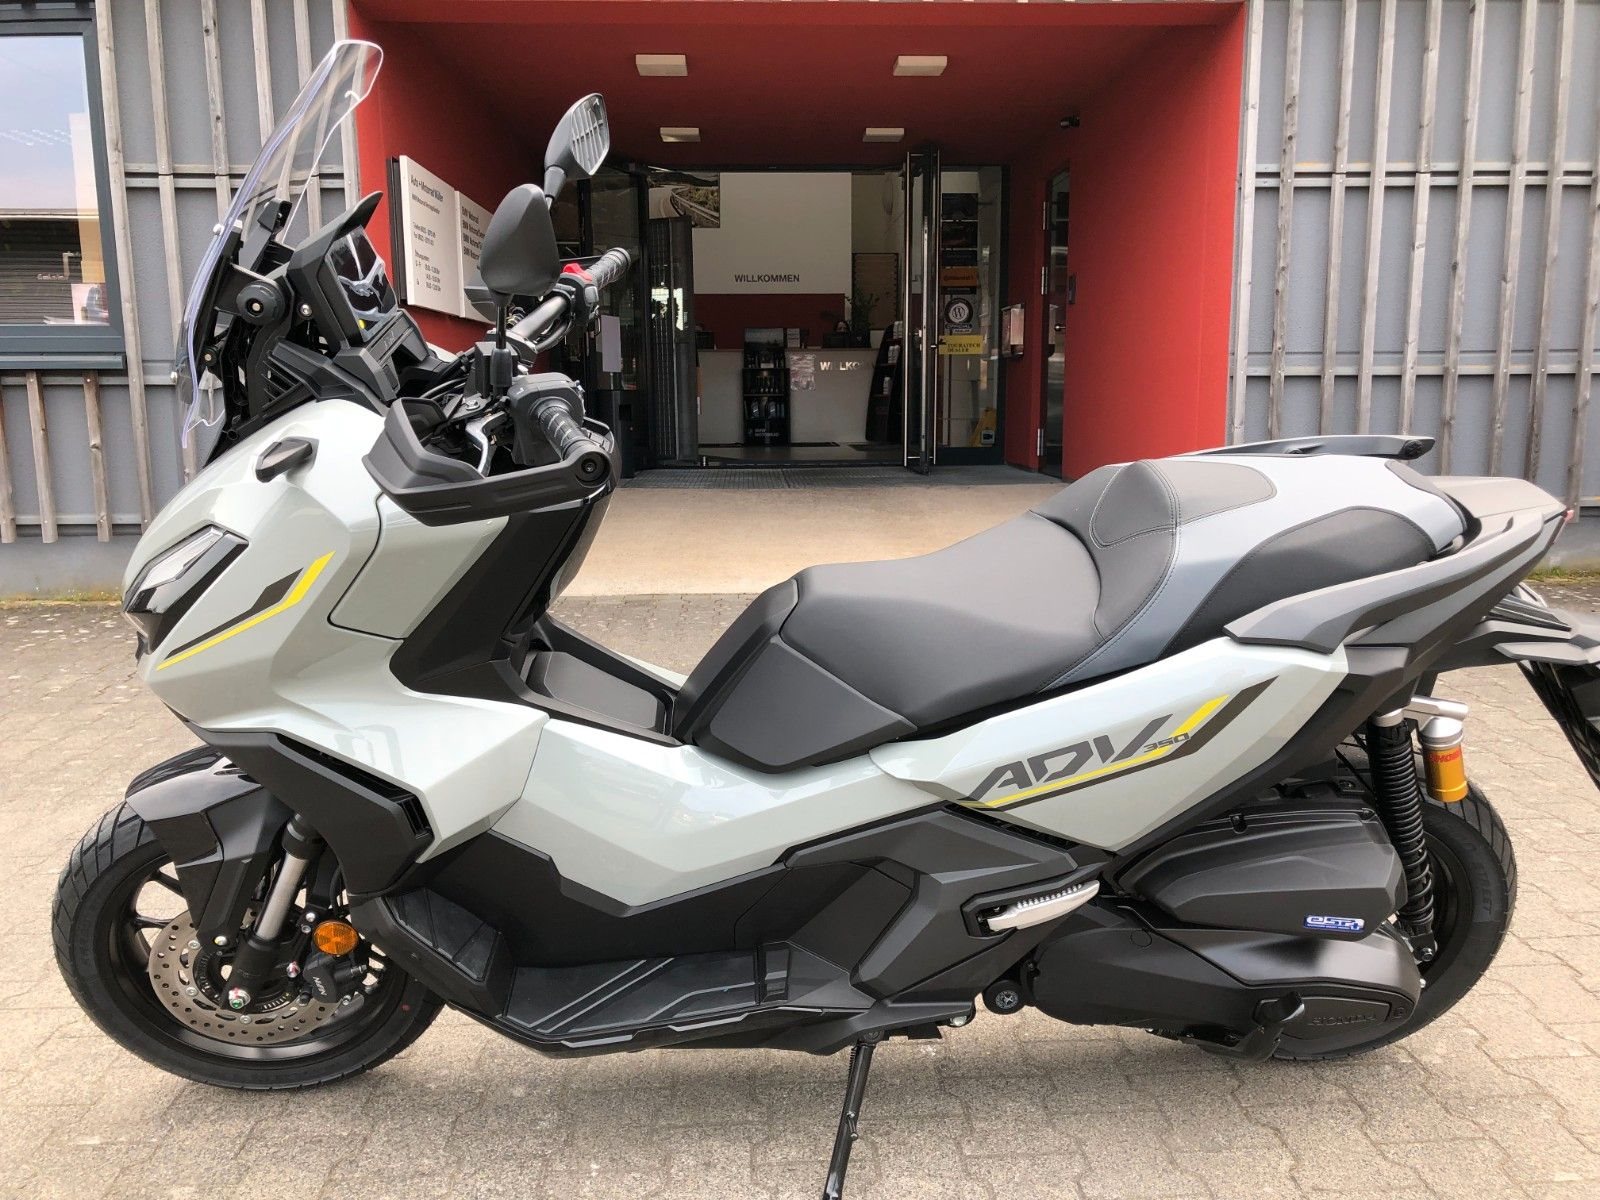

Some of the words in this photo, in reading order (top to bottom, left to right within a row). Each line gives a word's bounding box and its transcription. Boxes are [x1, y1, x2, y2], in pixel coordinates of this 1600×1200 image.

[734, 273, 800, 283] WILLKOMMEN
[1143, 732, 1190, 753] 350
[968, 713, 1174, 801] ADV
